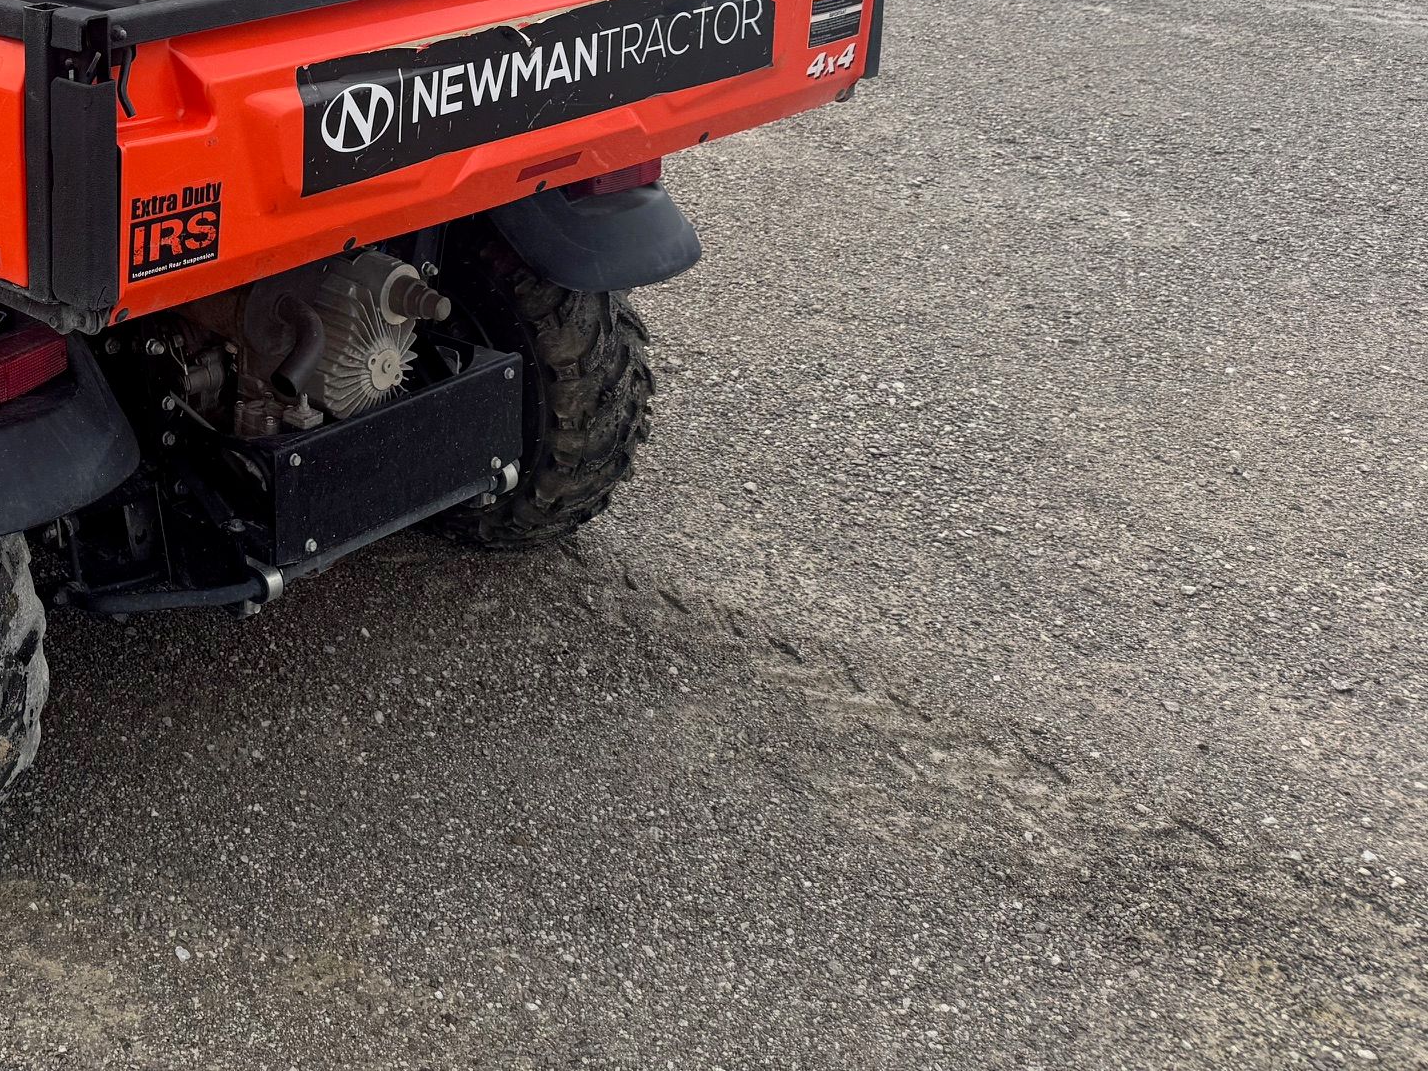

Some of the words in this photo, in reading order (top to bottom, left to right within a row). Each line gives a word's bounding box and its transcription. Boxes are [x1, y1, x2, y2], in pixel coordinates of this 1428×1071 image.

[806, 43, 856, 79] 4x4
[131, 193, 178, 221] Extra
[182, 181, 222, 209] Duty
[133, 211, 217, 266] IRS
[132, 265, 168, 279] Independent
[168, 260, 182, 270] Rear
[183, 252, 215, 265] Suspension
